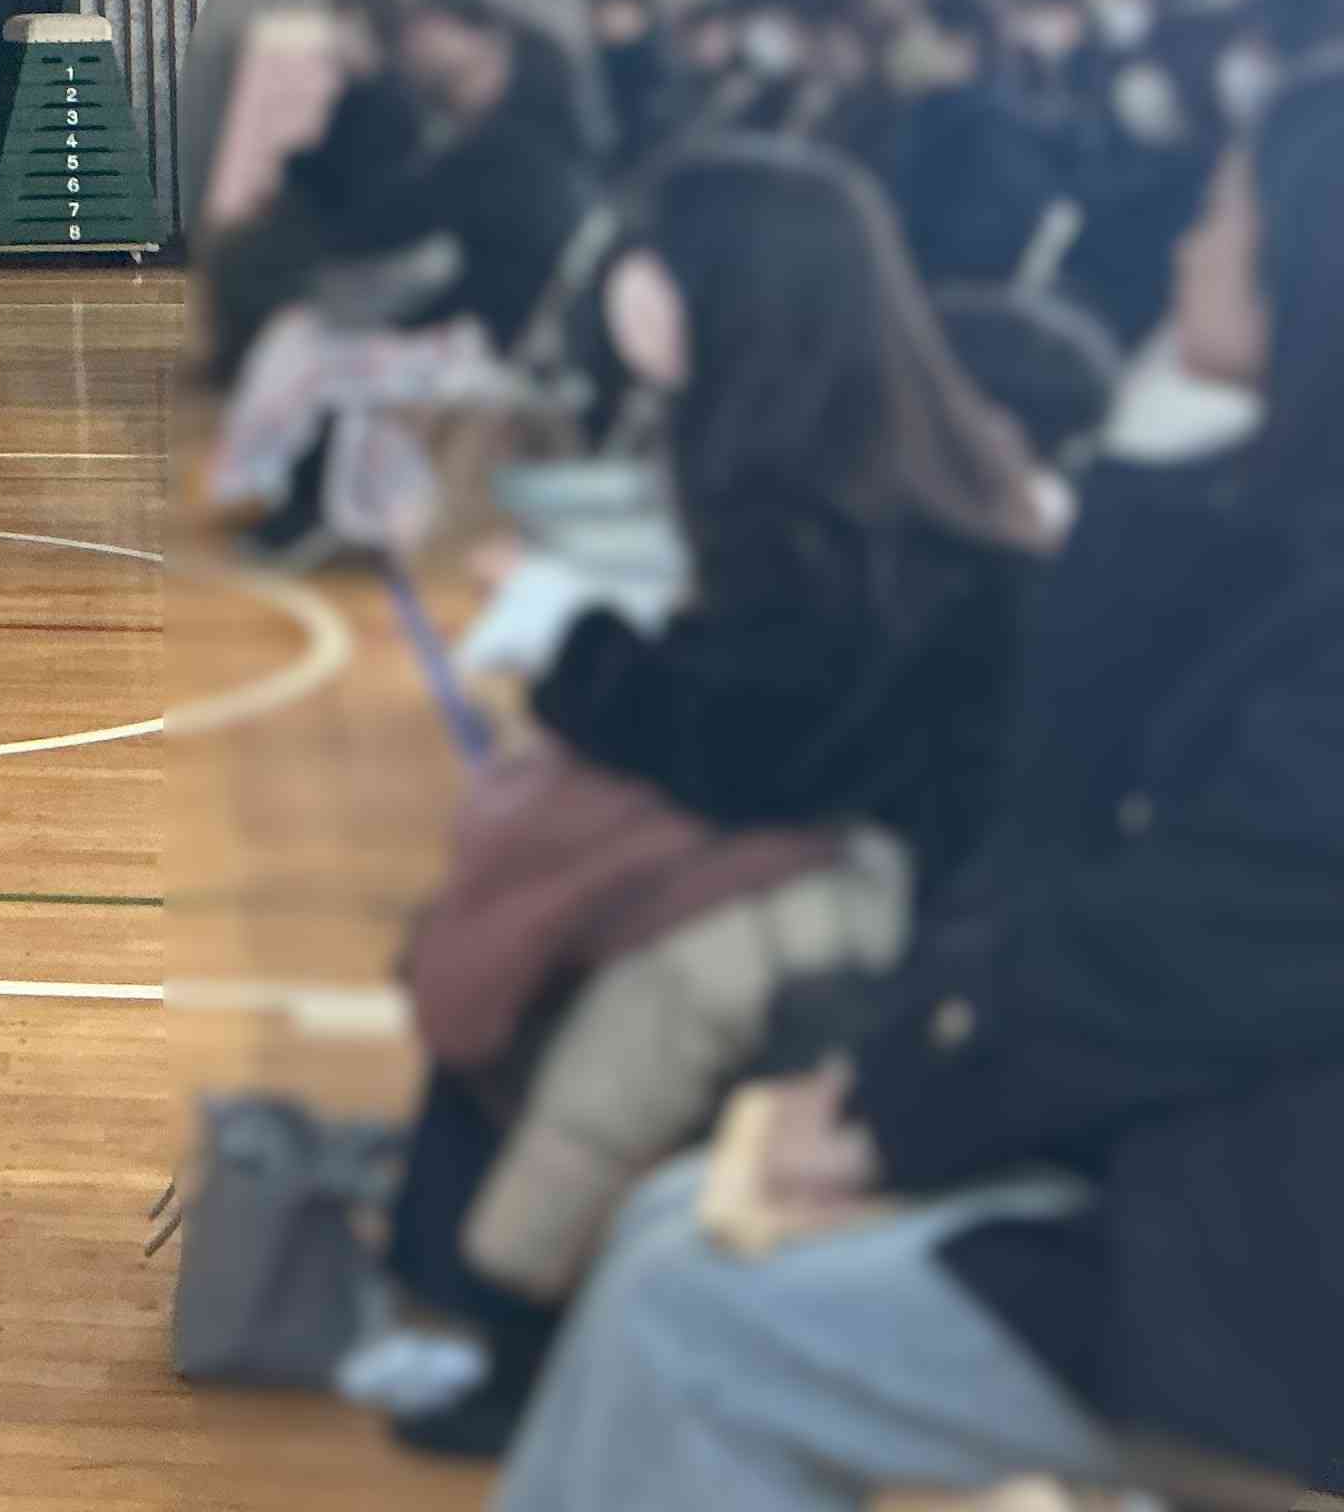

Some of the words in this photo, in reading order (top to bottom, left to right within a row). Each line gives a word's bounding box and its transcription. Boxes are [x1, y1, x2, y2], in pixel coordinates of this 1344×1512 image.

[66, 66, 75, 81] 1
[66, 88, 78, 102] 2
[67, 110, 79, 125] 3
[66, 133, 78, 148] 4
[67, 155, 79, 170] 5
[67, 178, 80, 193] 6
[68, 202, 80, 217] 7
[69, 225, 81, 240] 8
